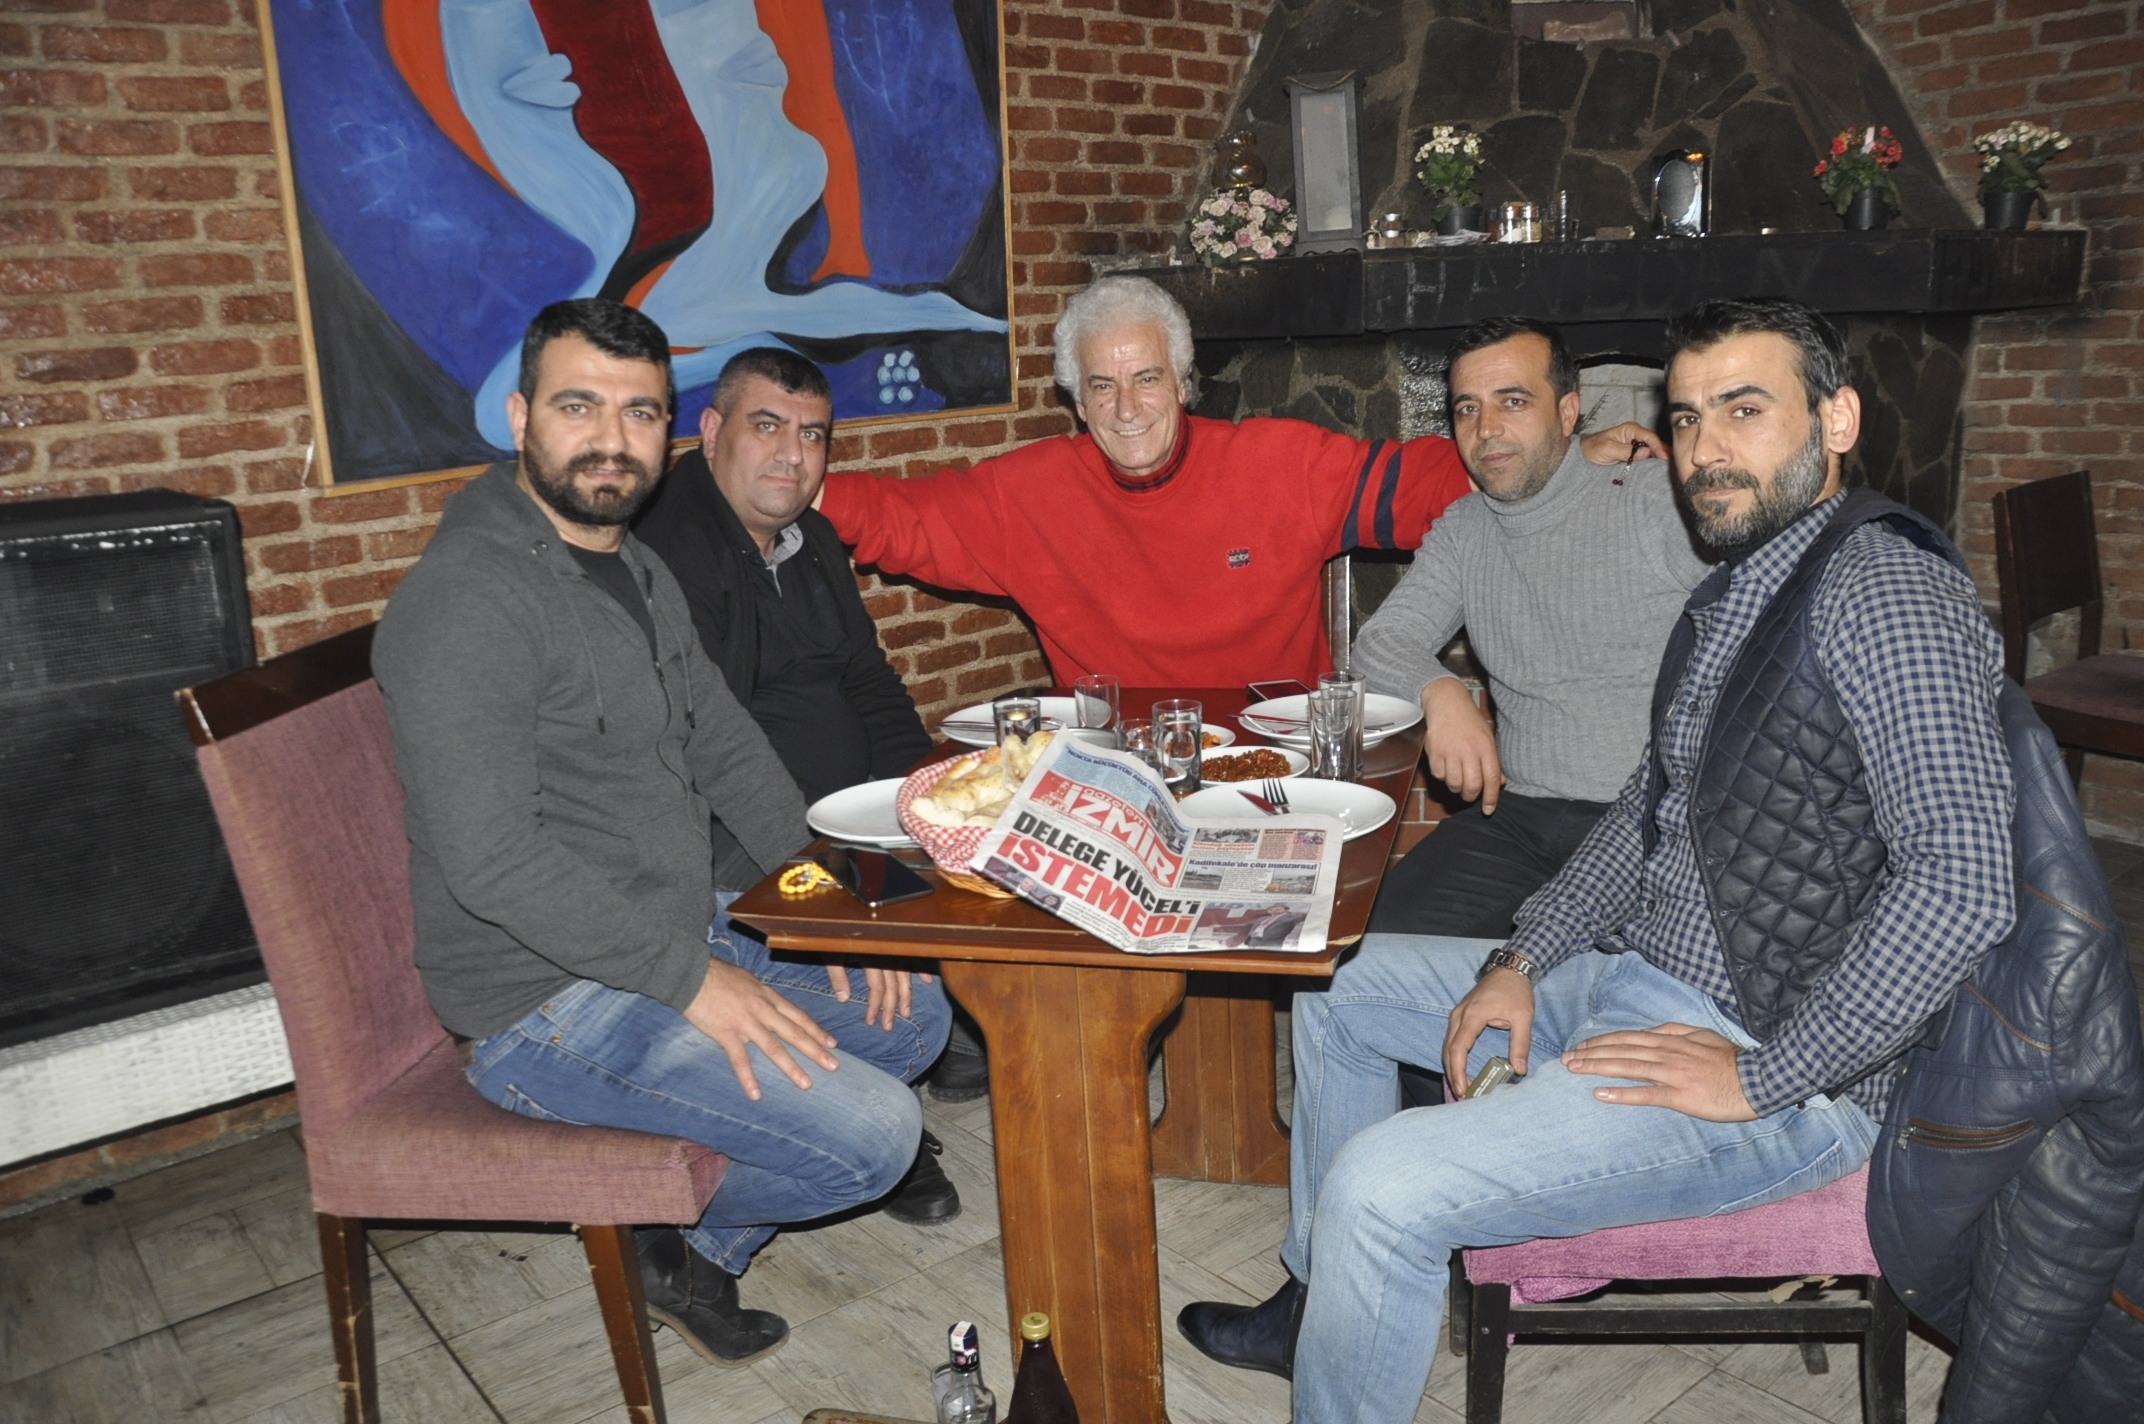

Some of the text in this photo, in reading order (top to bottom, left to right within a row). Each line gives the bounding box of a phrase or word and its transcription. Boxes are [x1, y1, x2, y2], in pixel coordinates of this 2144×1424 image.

[996, 831, 1194, 938] İSTEMEDİ
[1012, 811, 1112, 872] DELEGE
[1063, 783, 1178, 887] İZMİR
